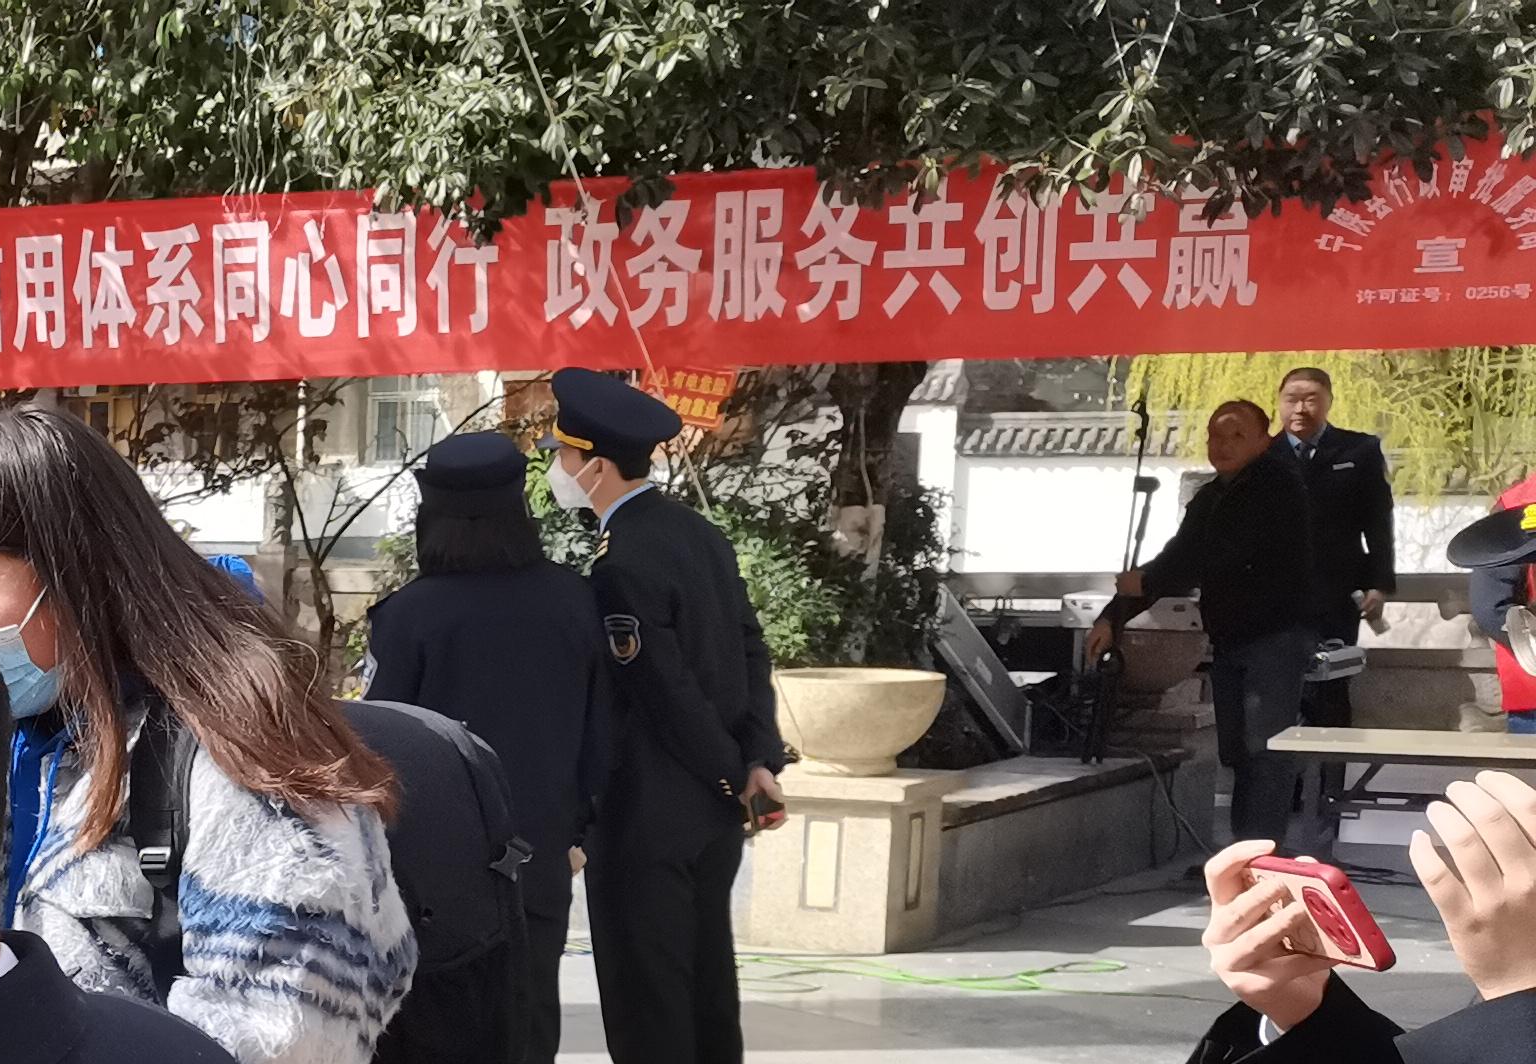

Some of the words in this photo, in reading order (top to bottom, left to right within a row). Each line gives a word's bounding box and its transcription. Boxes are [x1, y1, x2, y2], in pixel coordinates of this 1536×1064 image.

[544, 172, 1257, 330] 政务服务共创共赢
[1412, 235, 1467, 274] 宣
